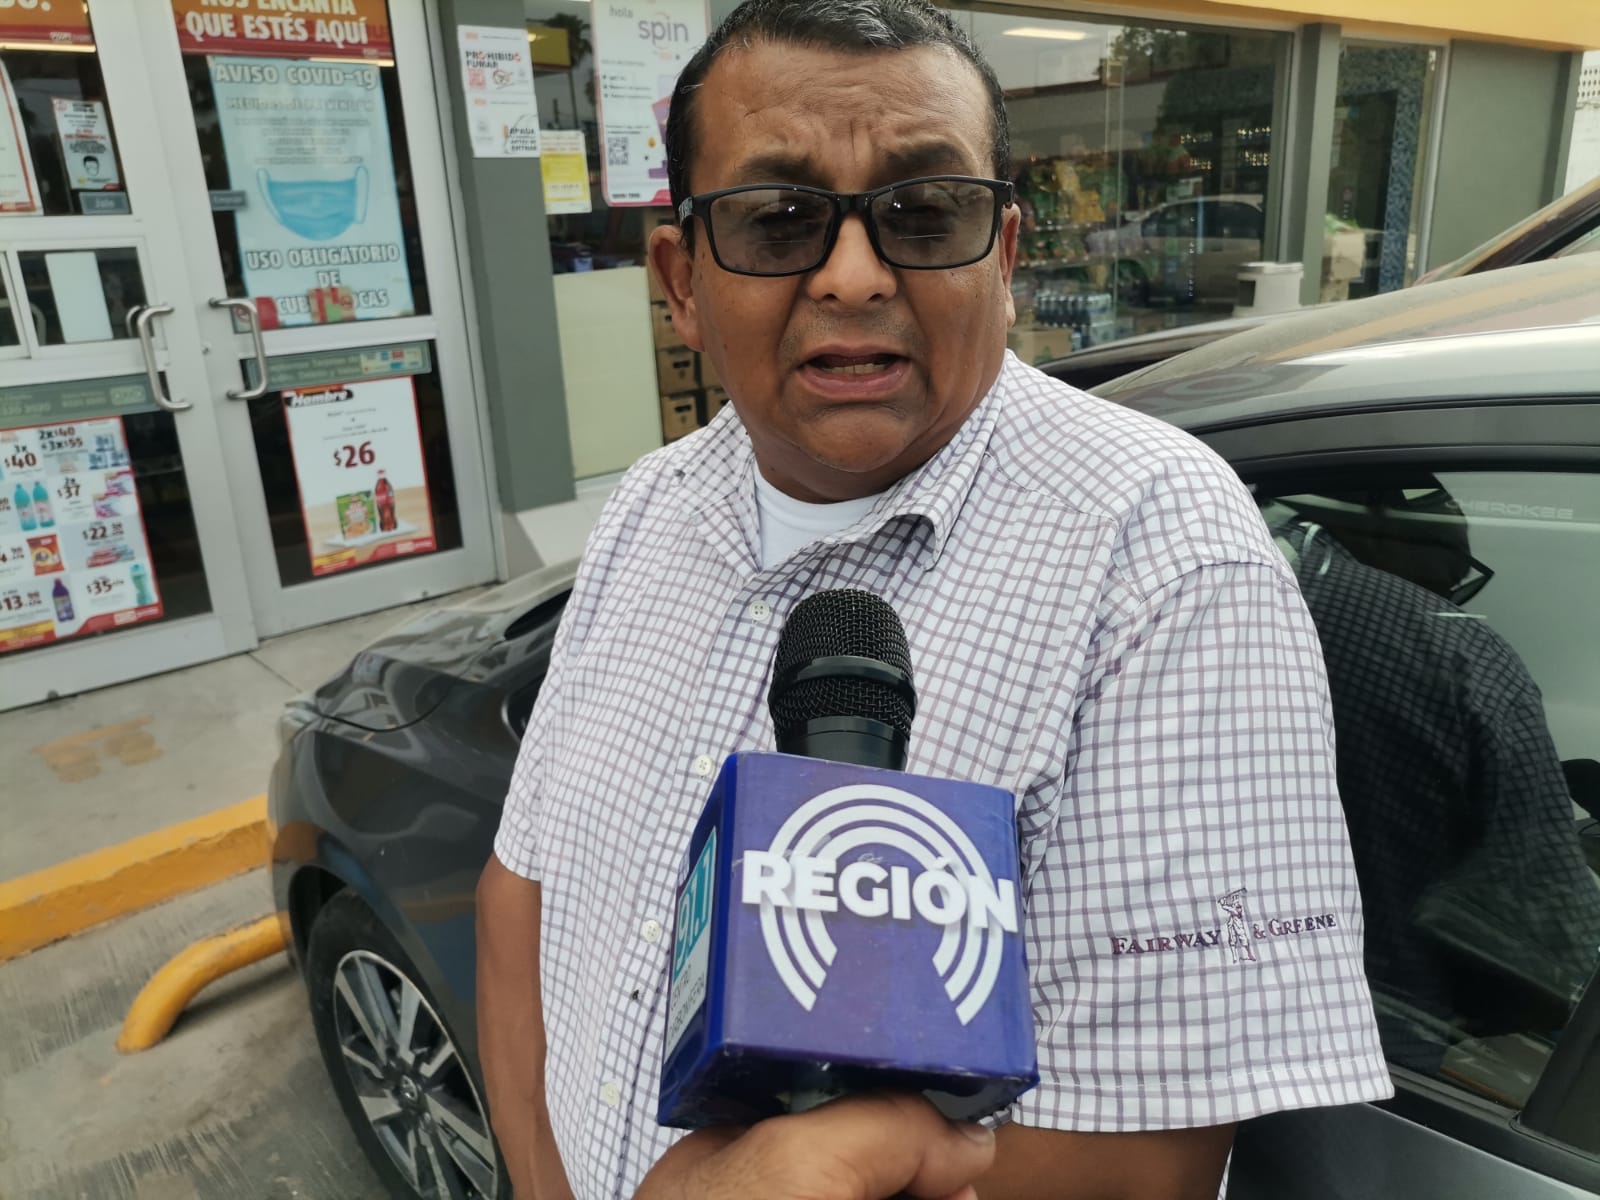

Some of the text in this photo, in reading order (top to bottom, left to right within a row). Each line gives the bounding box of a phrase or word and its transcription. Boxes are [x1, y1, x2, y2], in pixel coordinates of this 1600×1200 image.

[609, 5, 633, 19] hola
[185, 12, 369, 49] QUE ESTÉS AQUÍ
[638, 16, 689, 46] spin
[216, 64, 377, 89] AVISO COVID-19
[246, 244, 400, 270] USO OBLIGATORIO
[316, 270, 341, 288] DE
[277, 289, 389, 314] CUBCAS
[333, 441, 375, 468] $26
[742, 849, 1019, 933] REGIÓN
[675, 851, 710, 966] 91.1
[1111, 913, 1336, 955] FAIRWAY & GREENE
